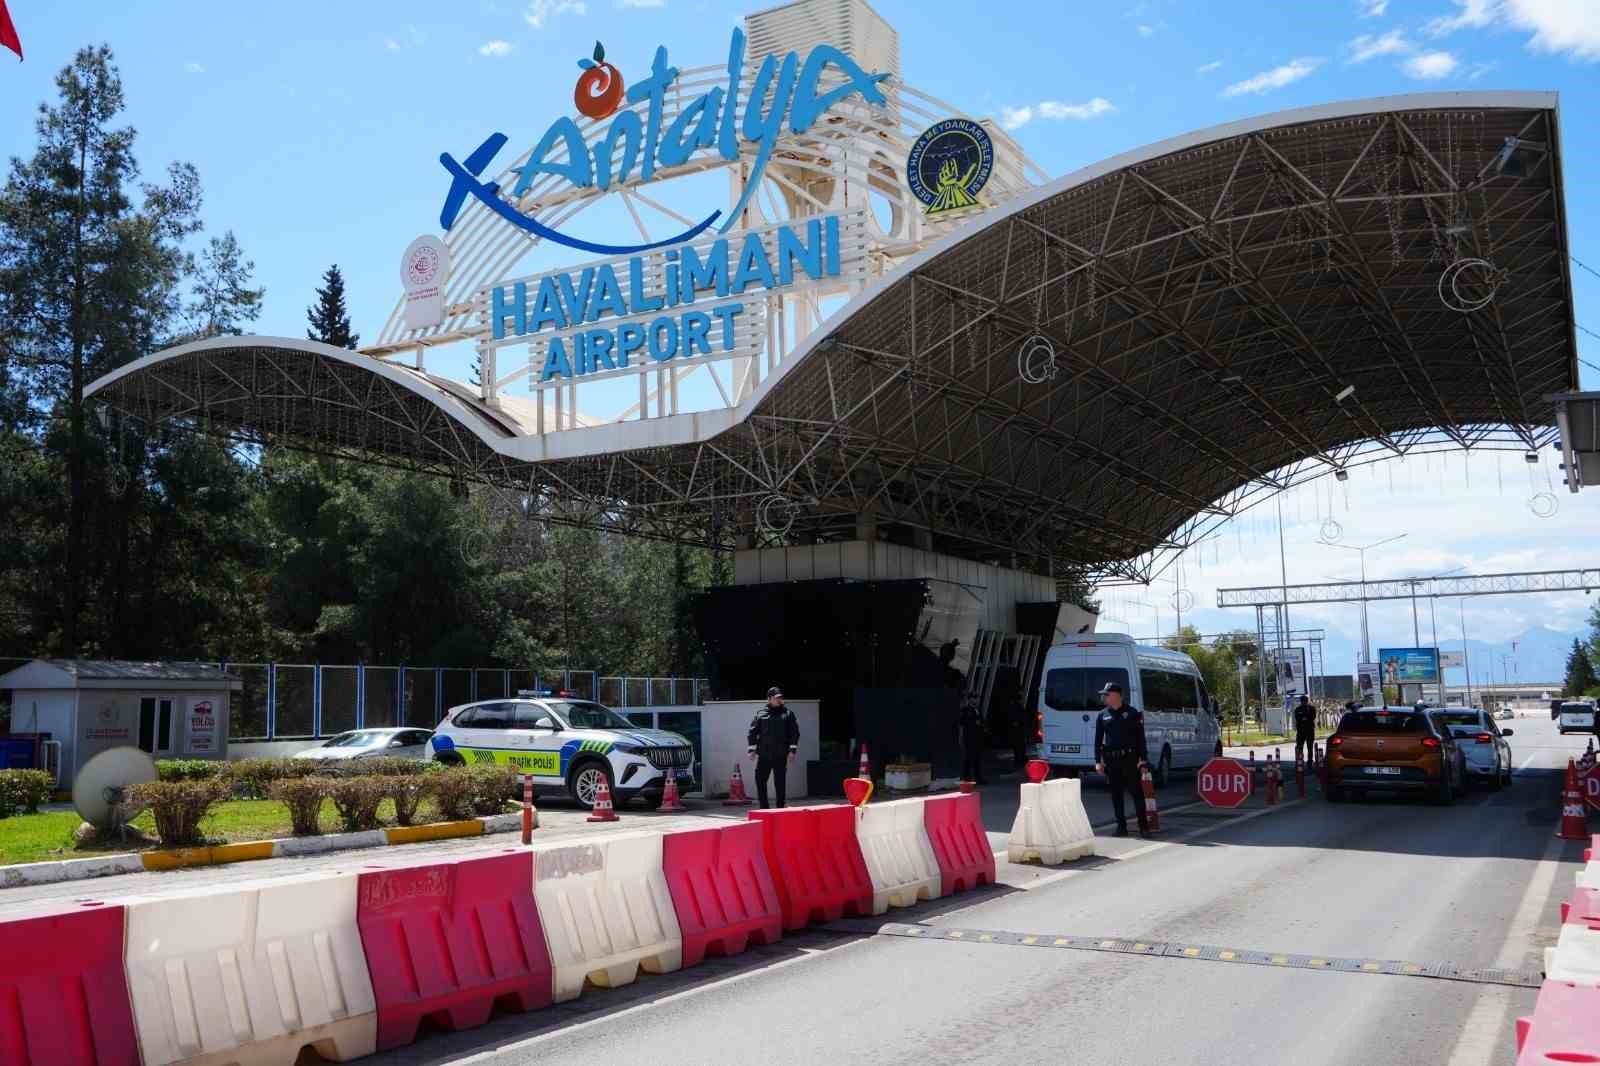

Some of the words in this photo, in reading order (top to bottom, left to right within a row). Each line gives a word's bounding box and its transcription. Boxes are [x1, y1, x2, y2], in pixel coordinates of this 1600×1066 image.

[511, 26, 891, 234] Antalya
[542, 303, 744, 382] AIRPORT
[1202, 774, 1245, 793] DUR
